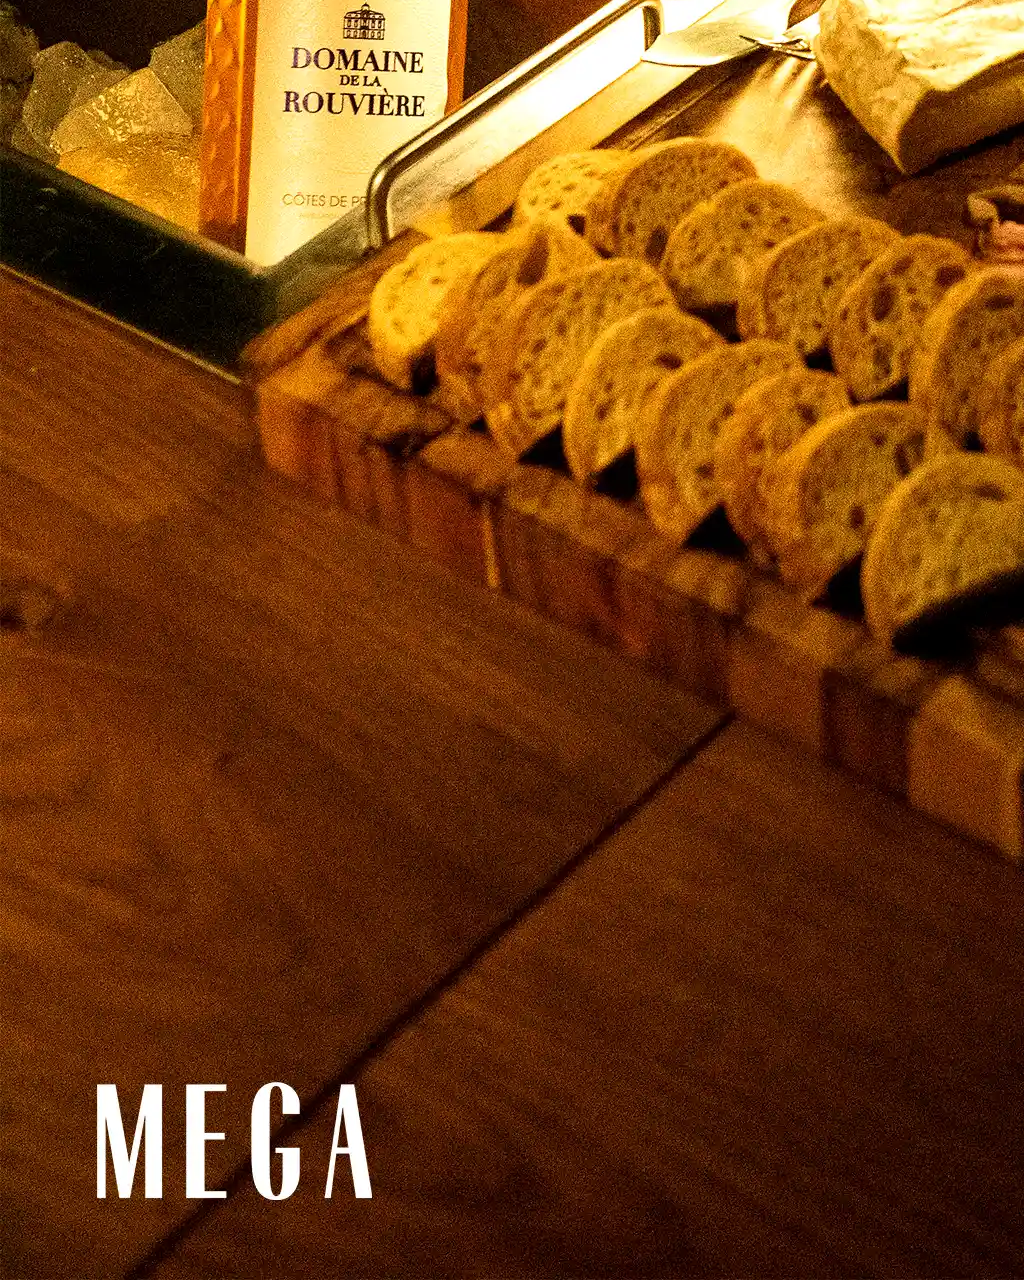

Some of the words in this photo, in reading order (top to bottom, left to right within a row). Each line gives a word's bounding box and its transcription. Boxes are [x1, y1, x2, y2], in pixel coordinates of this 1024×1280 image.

[291, 47, 424, 73] DOMAINE
[340, 75, 359, 86] DE
[363, 75, 381, 87] LA
[283, 87, 425, 117] ROUVIÈRE
[282, 192, 326, 207] CÔTES
[329, 195, 348, 207] DE
